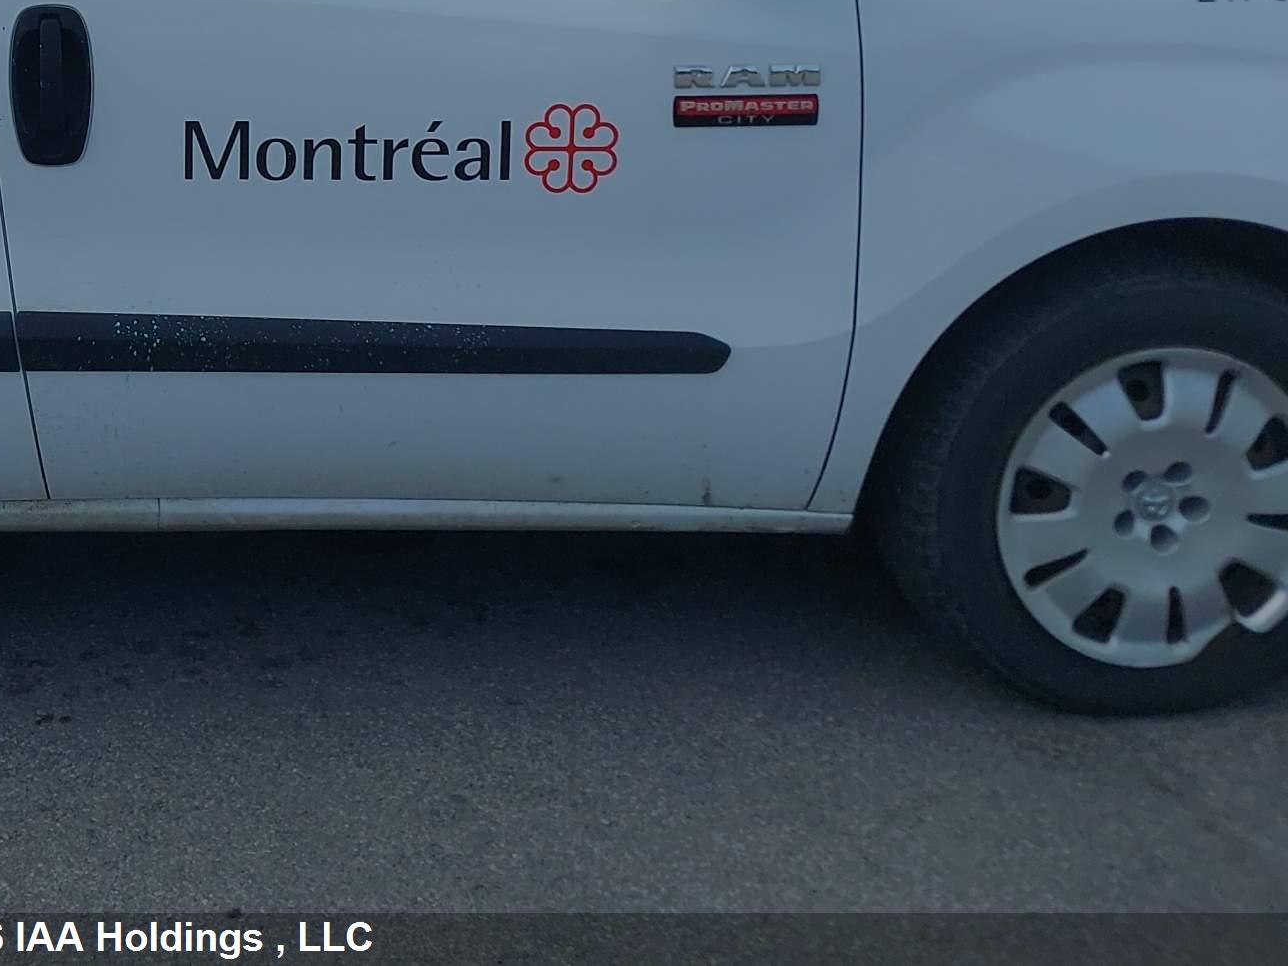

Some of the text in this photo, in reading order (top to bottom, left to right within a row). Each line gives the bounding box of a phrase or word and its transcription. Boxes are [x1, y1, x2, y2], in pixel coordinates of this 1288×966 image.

[673, 64, 822, 89] RAM
[717, 114, 776, 125] CITY
[183, 119, 512, 182] Montréal
